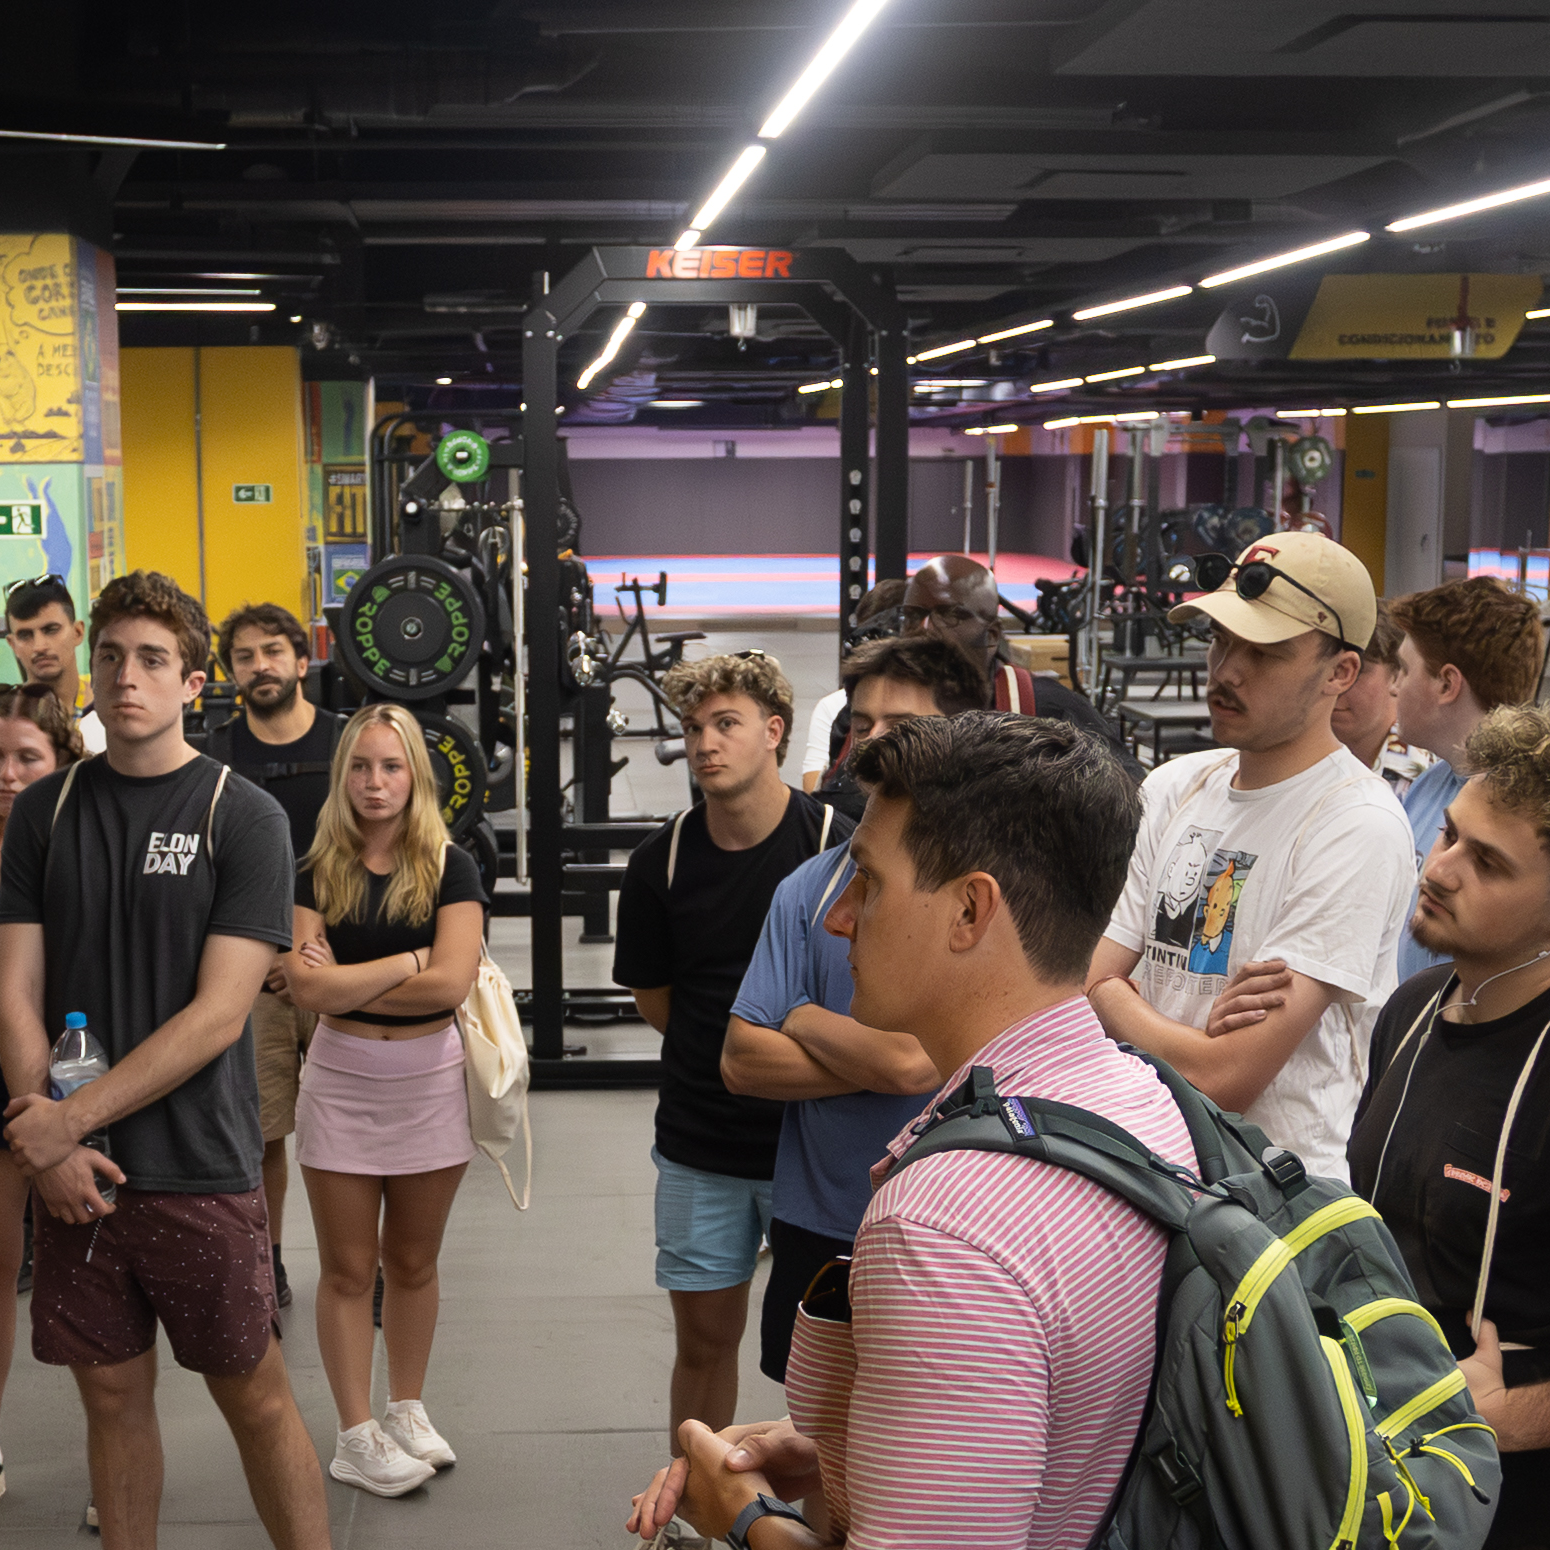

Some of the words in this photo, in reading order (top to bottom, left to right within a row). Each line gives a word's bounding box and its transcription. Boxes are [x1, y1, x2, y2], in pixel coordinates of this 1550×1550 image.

[645, 250, 793, 279] KEISER
[355, 602, 391, 677] ROPPE
[438, 735, 471, 809] ROPPE
[143, 852, 196, 875] DAY
[1146, 945, 1187, 971] TINTIN
